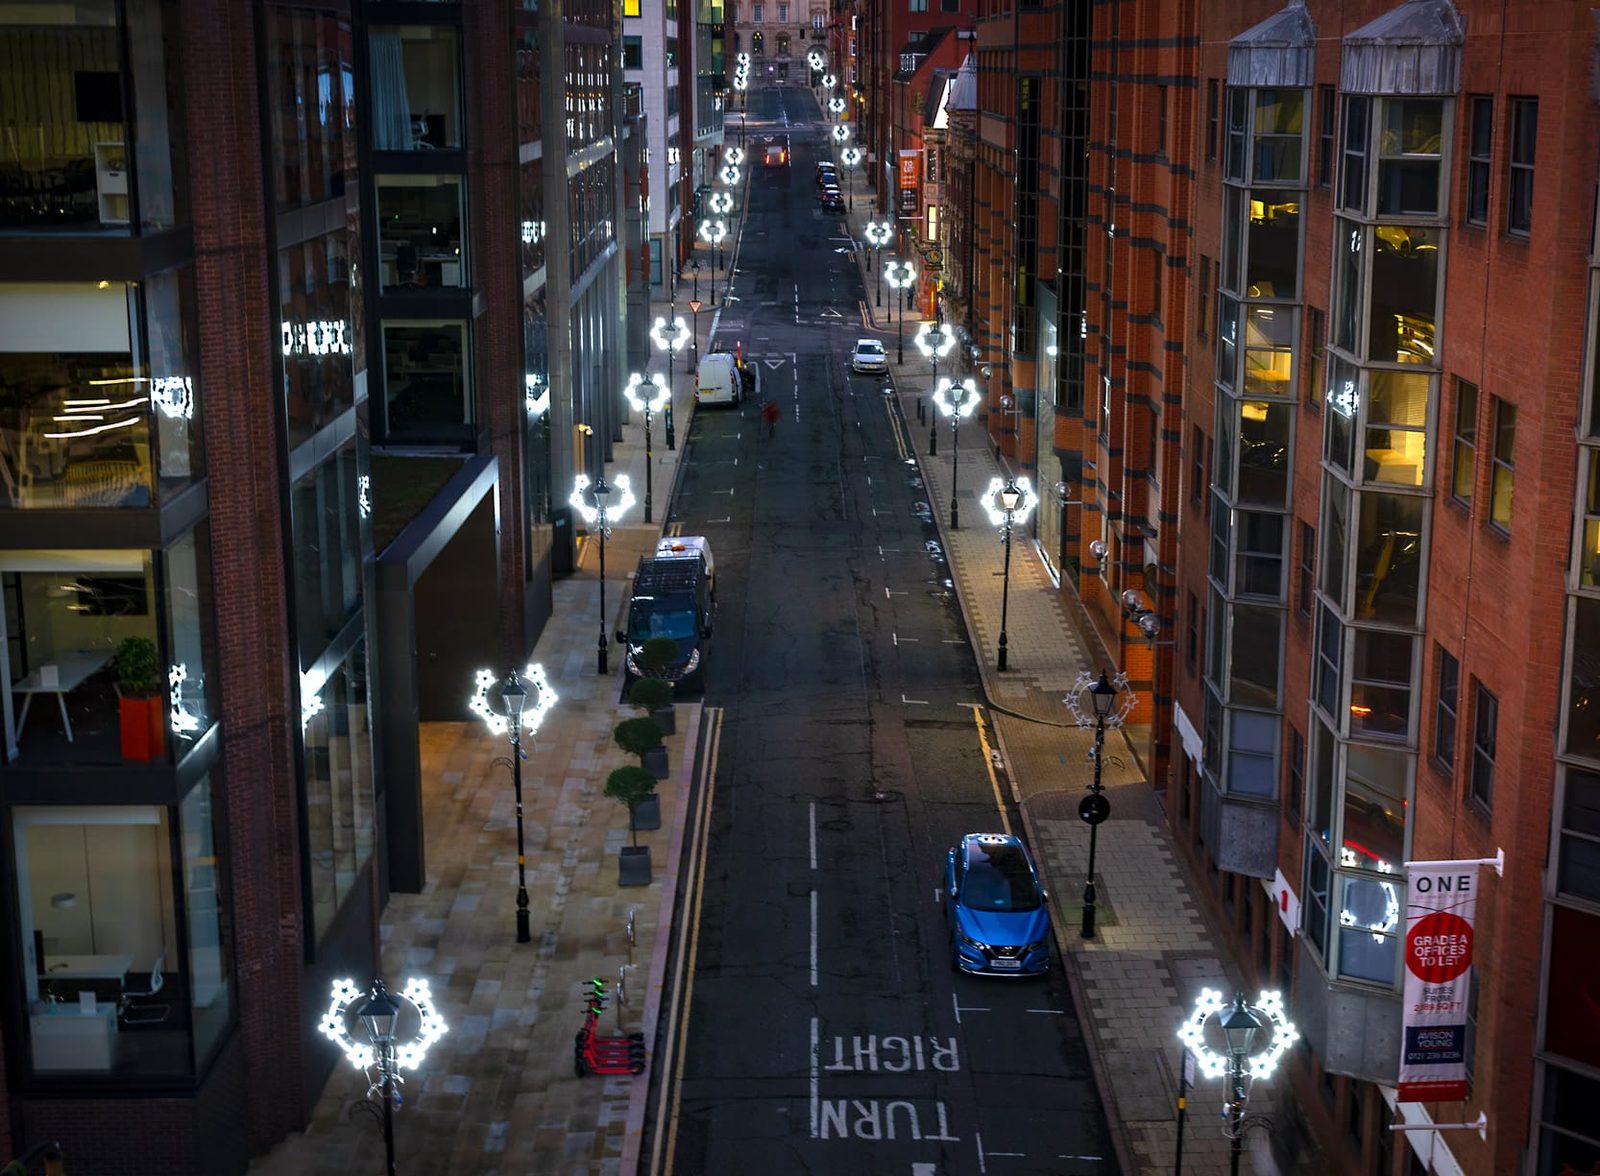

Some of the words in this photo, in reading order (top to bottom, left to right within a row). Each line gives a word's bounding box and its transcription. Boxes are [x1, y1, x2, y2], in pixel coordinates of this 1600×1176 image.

[1416, 876, 1471, 893] ONE
[1413, 934, 1457, 946] GRADE
[1459, 934, 1468, 945] A
[1414, 945, 1467, 957] OFFICES
[1419, 957, 1436, 967] TO
[1438, 955, 1460, 966] LET
[1417, 1031, 1454, 1041] AVISON
[1417, 1039, 1454, 1048] YOUNG
[824, 1035, 960, 1072] RIGHT
[820, 1100, 960, 1142] TURN
